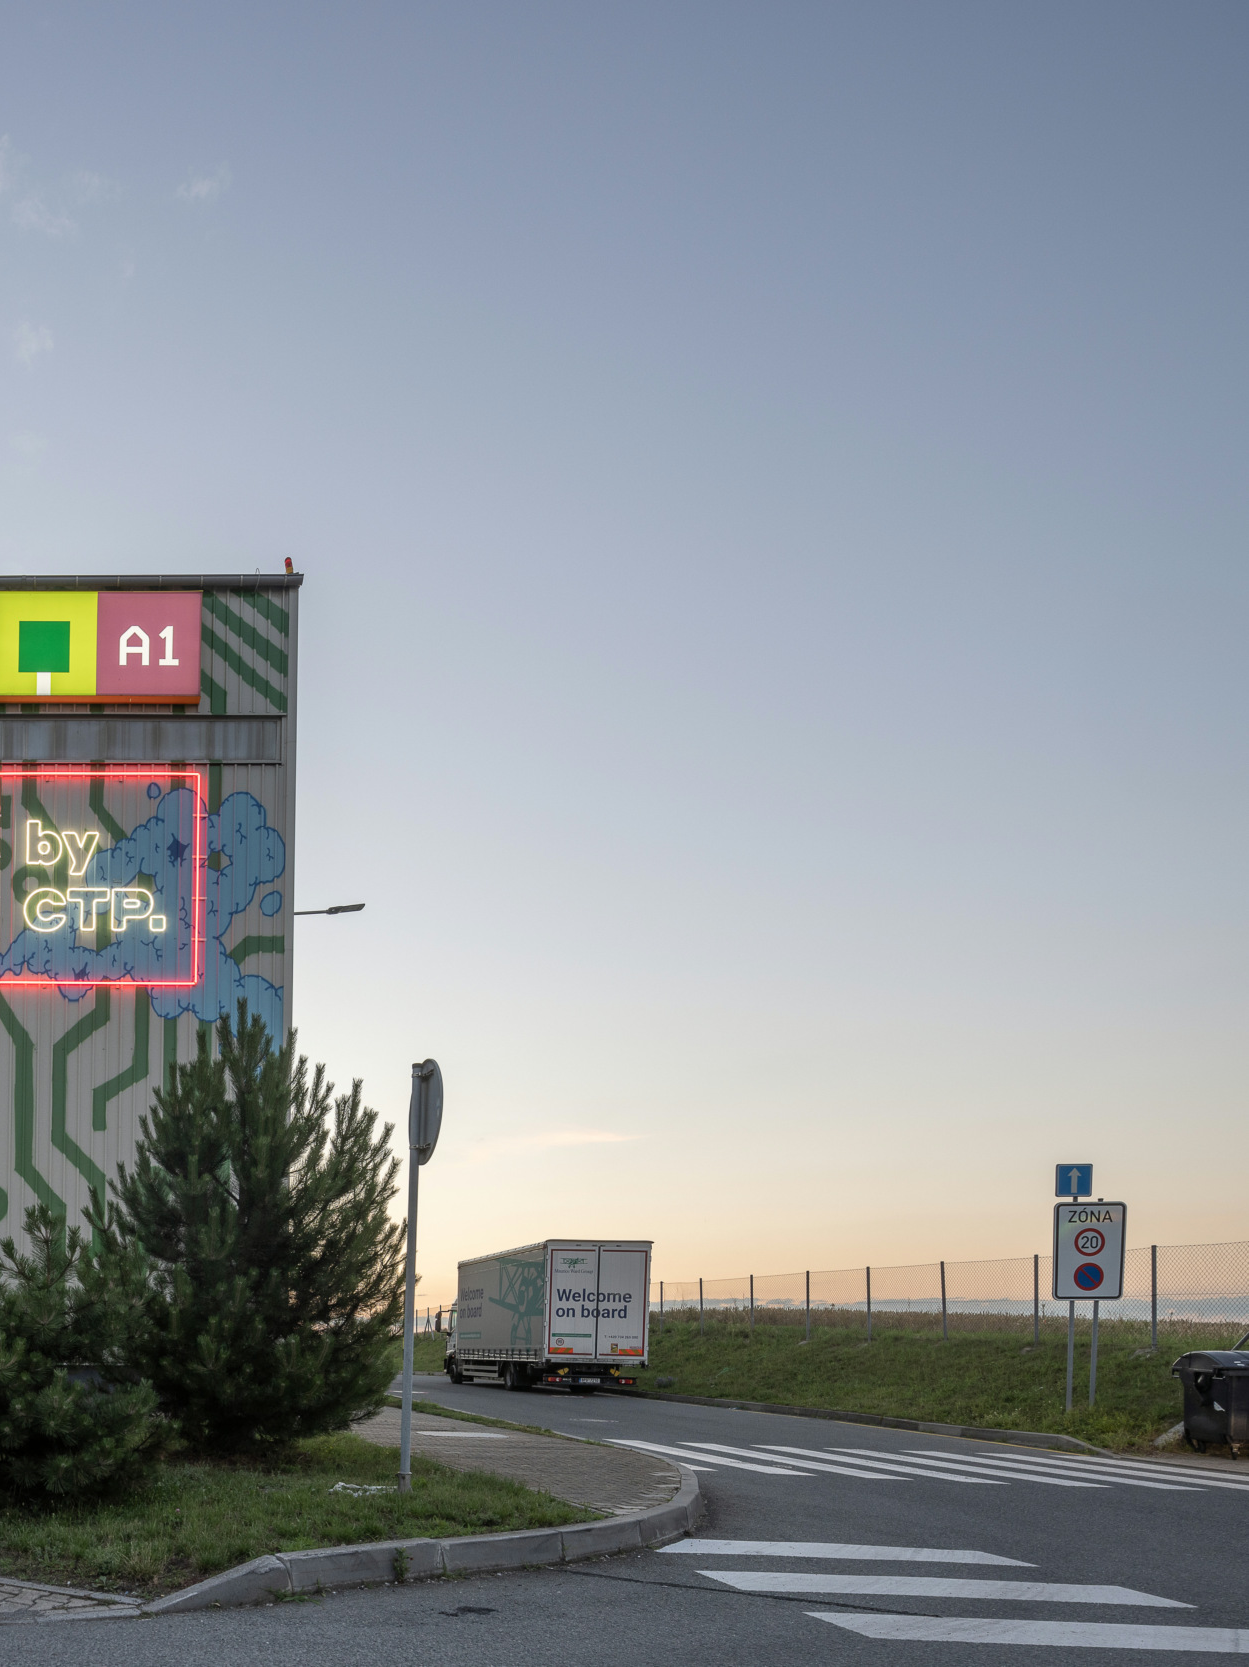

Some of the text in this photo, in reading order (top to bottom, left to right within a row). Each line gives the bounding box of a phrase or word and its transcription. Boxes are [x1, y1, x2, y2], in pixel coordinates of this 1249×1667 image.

[118, 625, 180, 666] A1
[25, 819, 100, 876] by
[22, 887, 168, 933] CTP.
[1068, 1207, 1113, 1223] ZÓNA
[1080, 1235, 1099, 1249] 20
[460, 1286, 484, 1302] Welcome
[556, 1288, 632, 1303] Welcome
[460, 1303, 482, 1319] on board
[555, 1304, 628, 1319] on board
